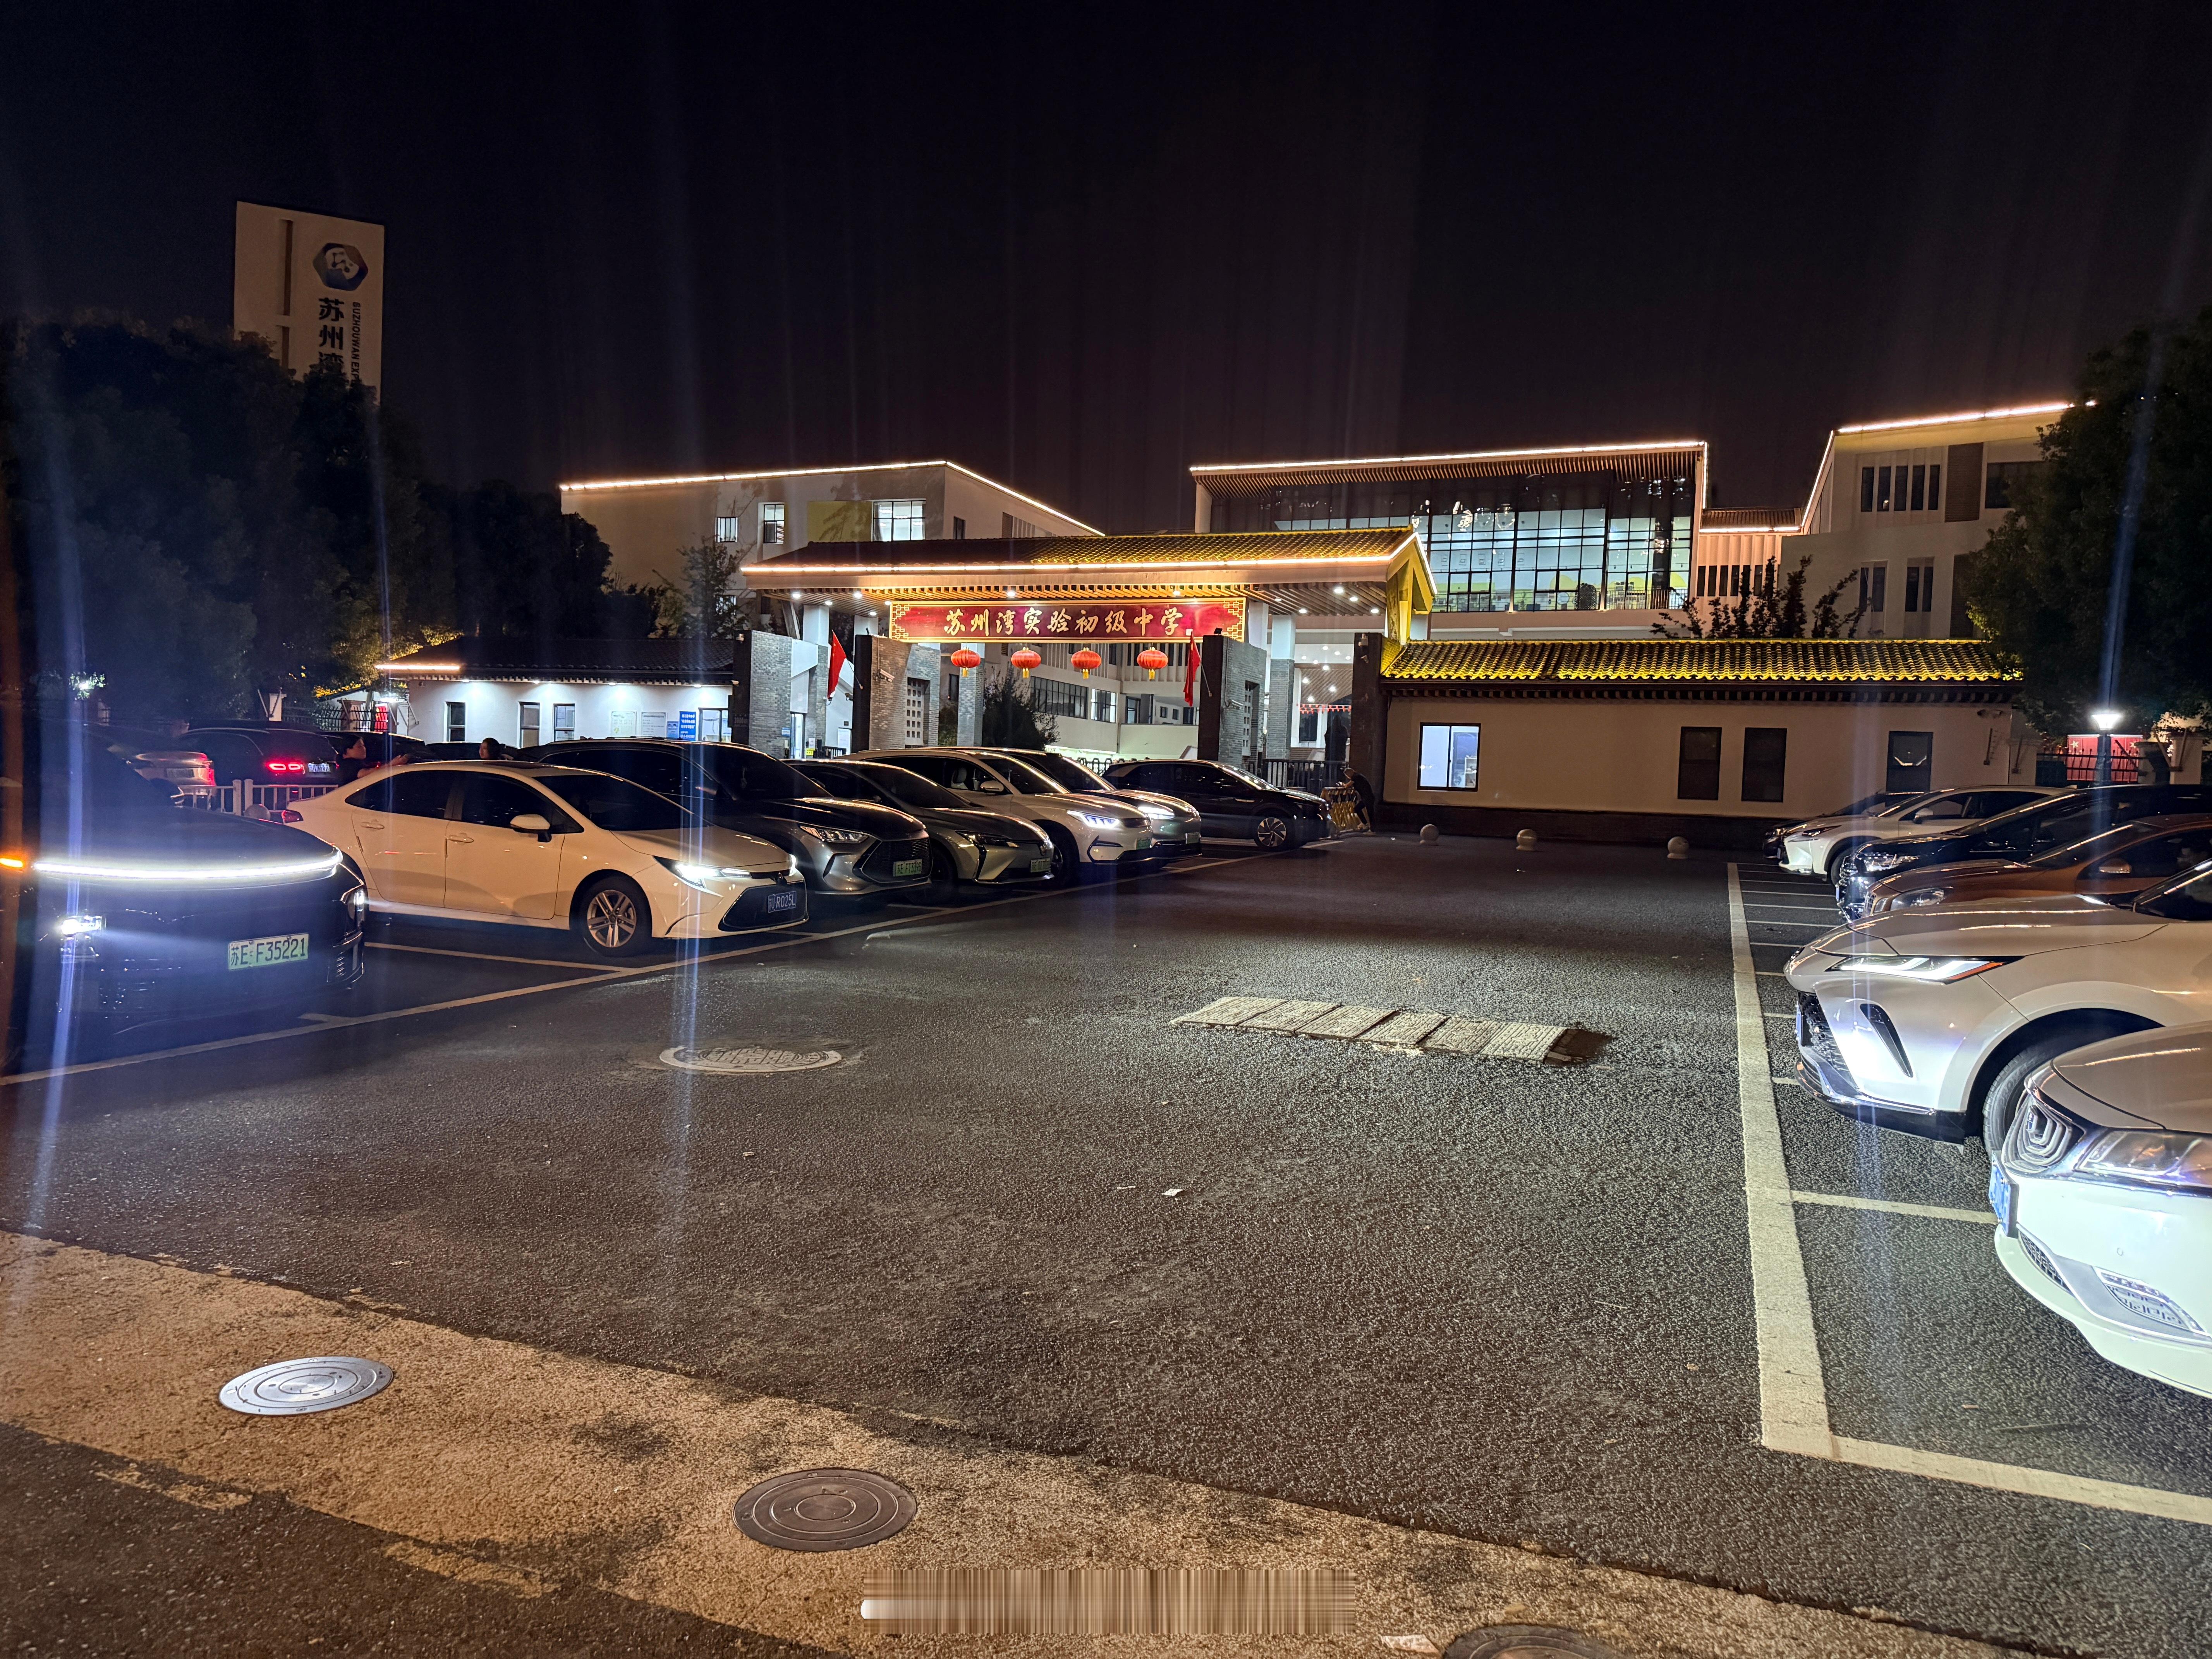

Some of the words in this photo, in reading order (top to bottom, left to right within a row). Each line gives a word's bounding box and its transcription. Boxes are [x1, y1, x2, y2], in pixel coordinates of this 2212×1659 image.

[943, 606, 1183, 636] 苏州湾实验初级中学
